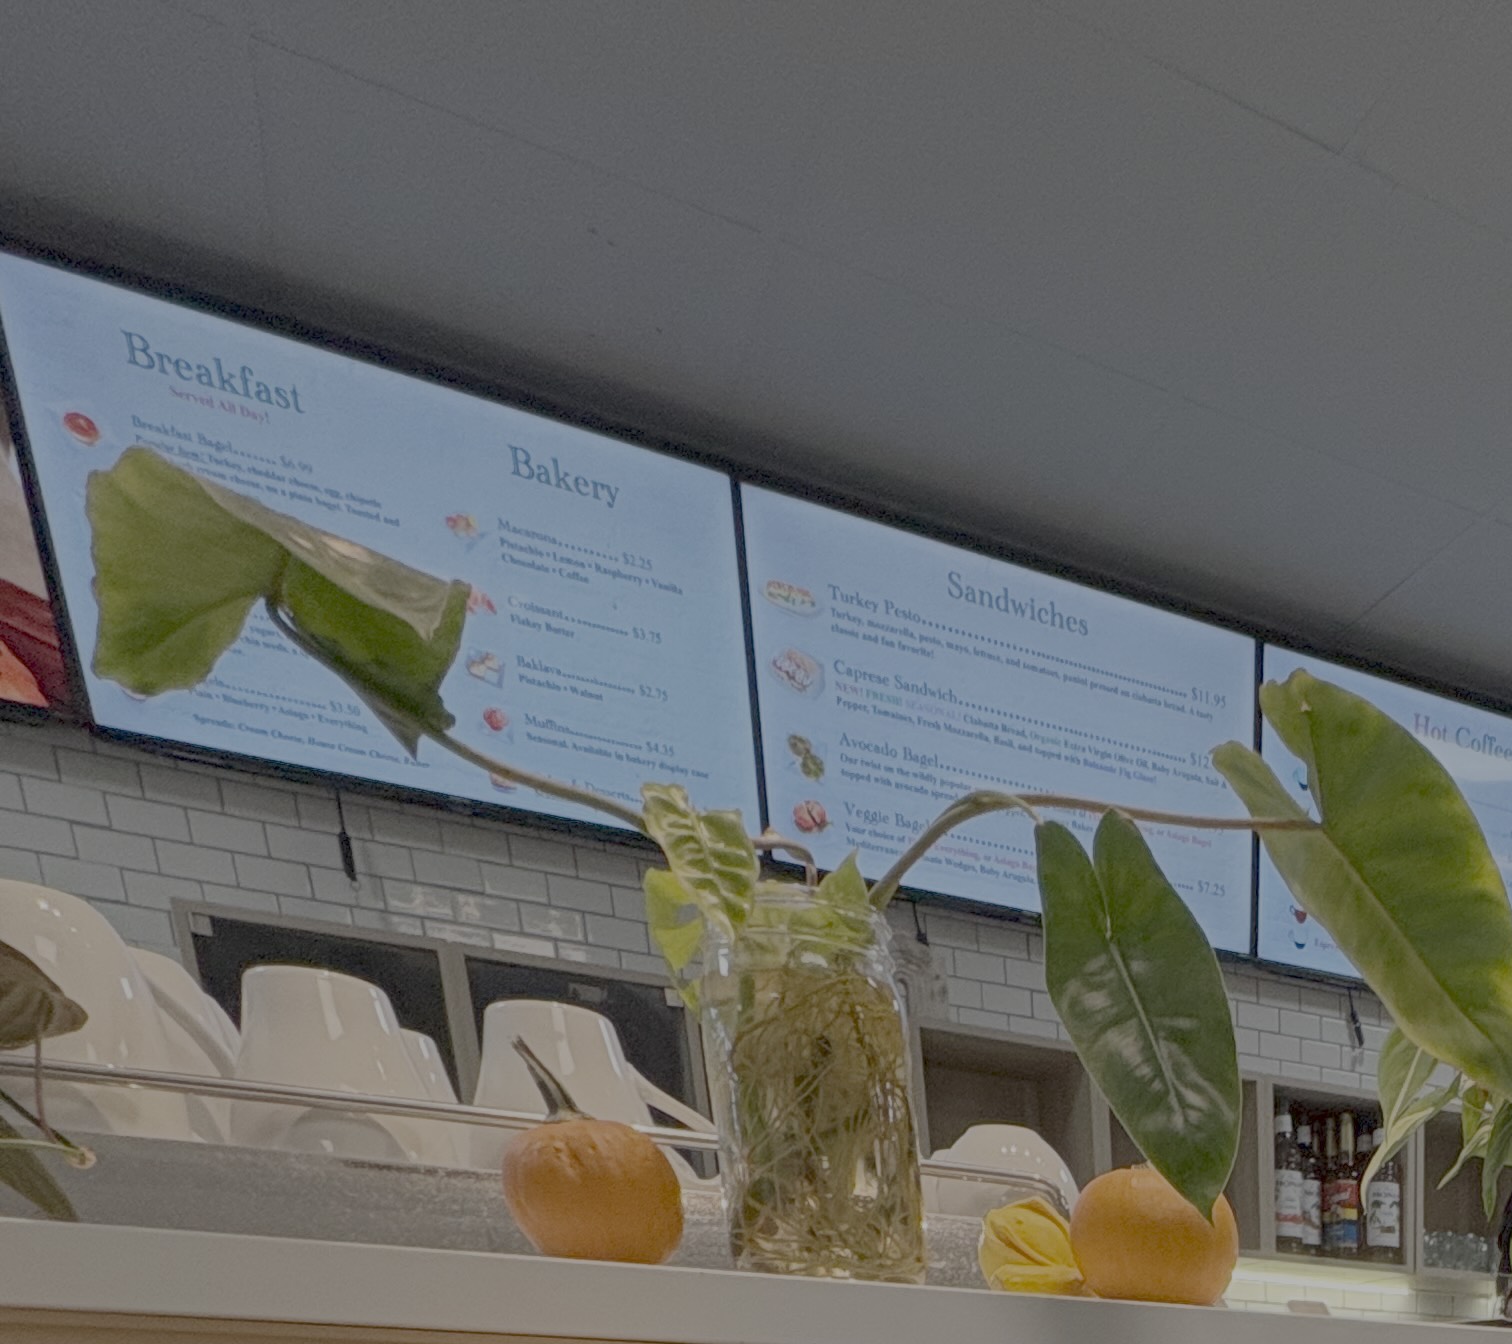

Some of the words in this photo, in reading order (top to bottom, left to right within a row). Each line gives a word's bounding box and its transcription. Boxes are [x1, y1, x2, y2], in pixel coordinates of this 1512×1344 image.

[120, 329, 305, 413] Breakfast
[167, 384, 214, 408] Served
[219, 399, 237, 414] All
[239, 405, 271, 426] Day!
[130, 415, 192, 441] Breakfast
[196, 432, 234, 455] Bagel
[508, 445, 621, 508] Bakery
[497, 519, 556, 545] Macarons
[621, 552, 653, 571] $2.25
[498, 537, 544, 558] Pistachio
[552, 551, 586, 569] Lemon
[594, 563, 643, 585] Raspberry
[500, 553, 550, 573] Chocolate
[557, 568, 589, 583] Coffee
[948, 573, 1088, 633] Sandwiches
[631, 626, 661, 643] $3.75
[827, 584, 878, 613] Turkey
[883, 600, 921, 623] Pesto
[1192, 687, 1226, 709] $11.95
[862, 630, 878, 644] and
[515, 656, 561, 676] Baklava
[639, 684, 668, 701] $2.75
[518, 674, 561, 691] Pistachio
[833, 659, 889, 690] Caprese
[894, 674, 957, 704] Sandwich
[329, 702, 361, 716] $3.50
[838, 731, 897, 757] Avocado
[902, 747, 938, 770] Bagel
[1413, 712, 1447, 742] Hot
[1455, 725, 1512, 761] Coffee
[843, 801, 889, 829] Veggie
[1197, 880, 1224, 897] $7.25
